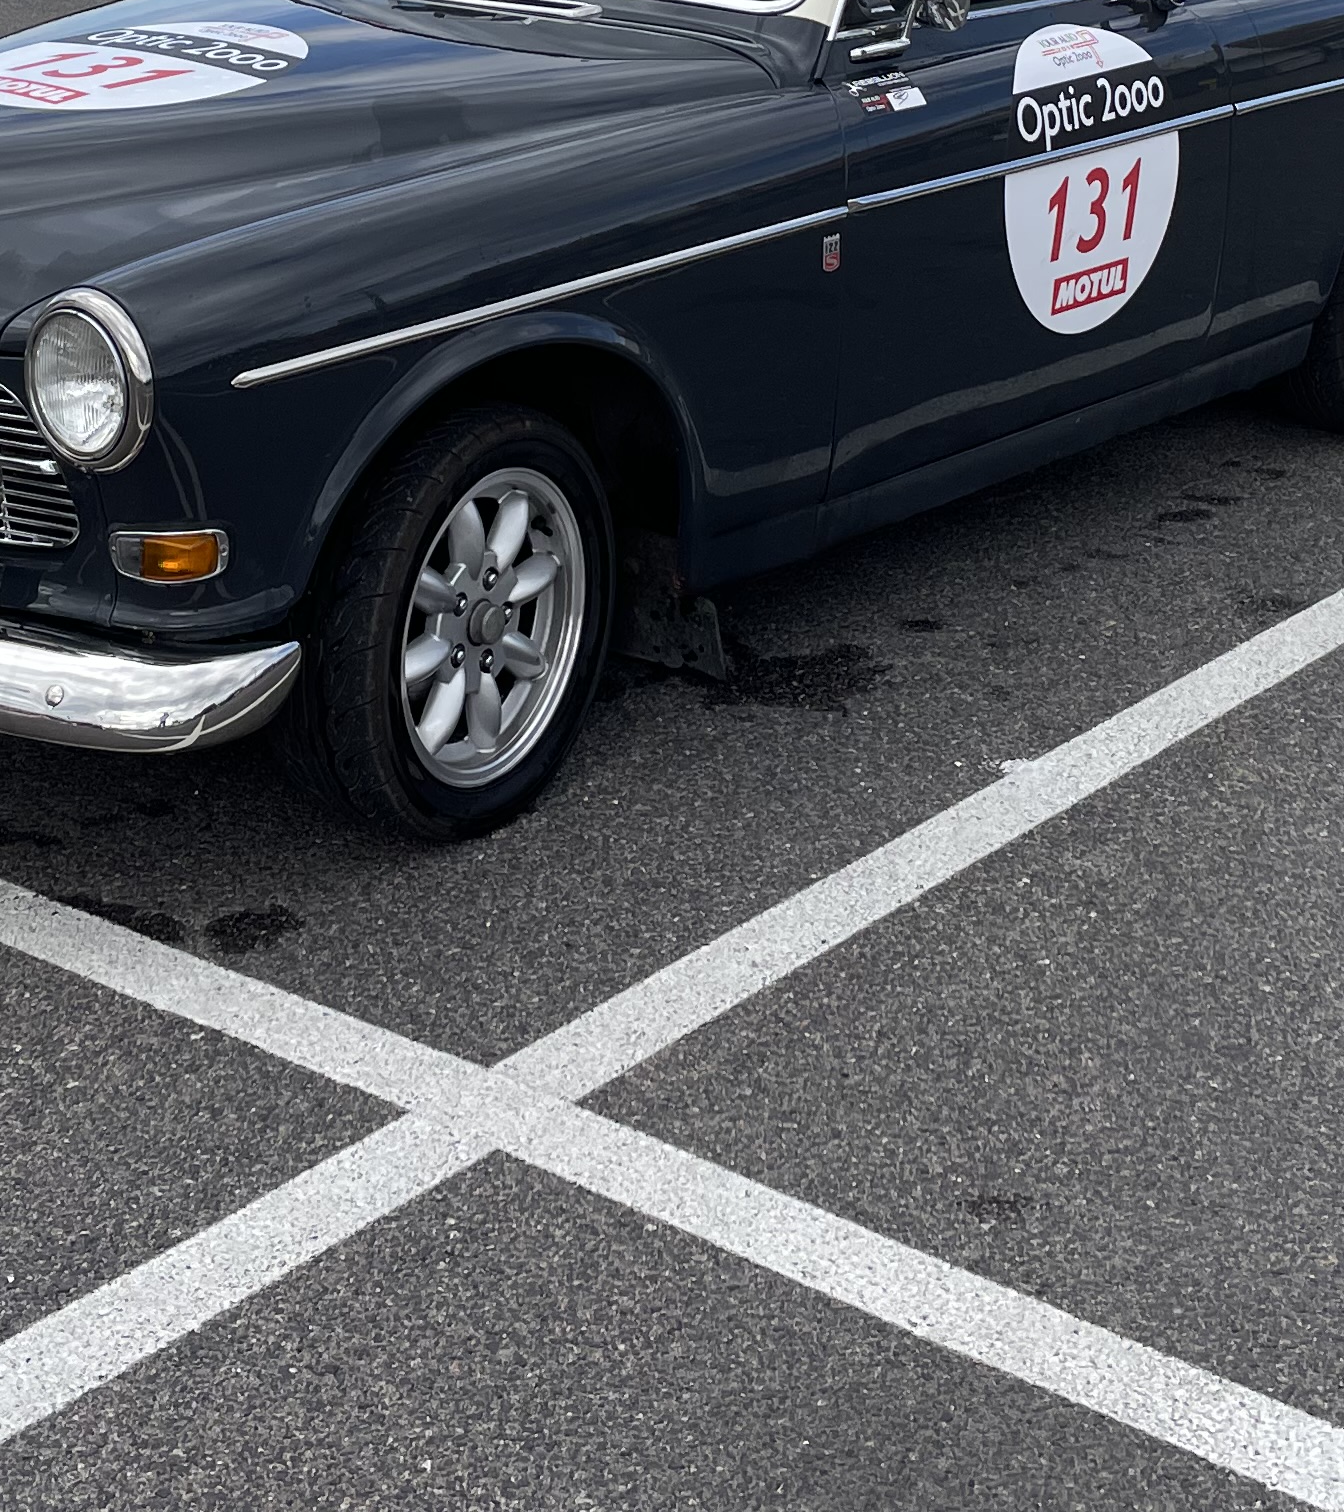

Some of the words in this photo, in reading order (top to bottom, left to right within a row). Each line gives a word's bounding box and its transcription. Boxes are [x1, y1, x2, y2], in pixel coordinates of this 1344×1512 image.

[87, 29, 193, 52] Optic
[6, 51, 196, 90] 131
[1017, 85, 1094, 152] Optic
[1096, 75, 1165, 123] 2000
[1048, 157, 1143, 263] 131
[1055, 262, 1126, 310] MOTUL
